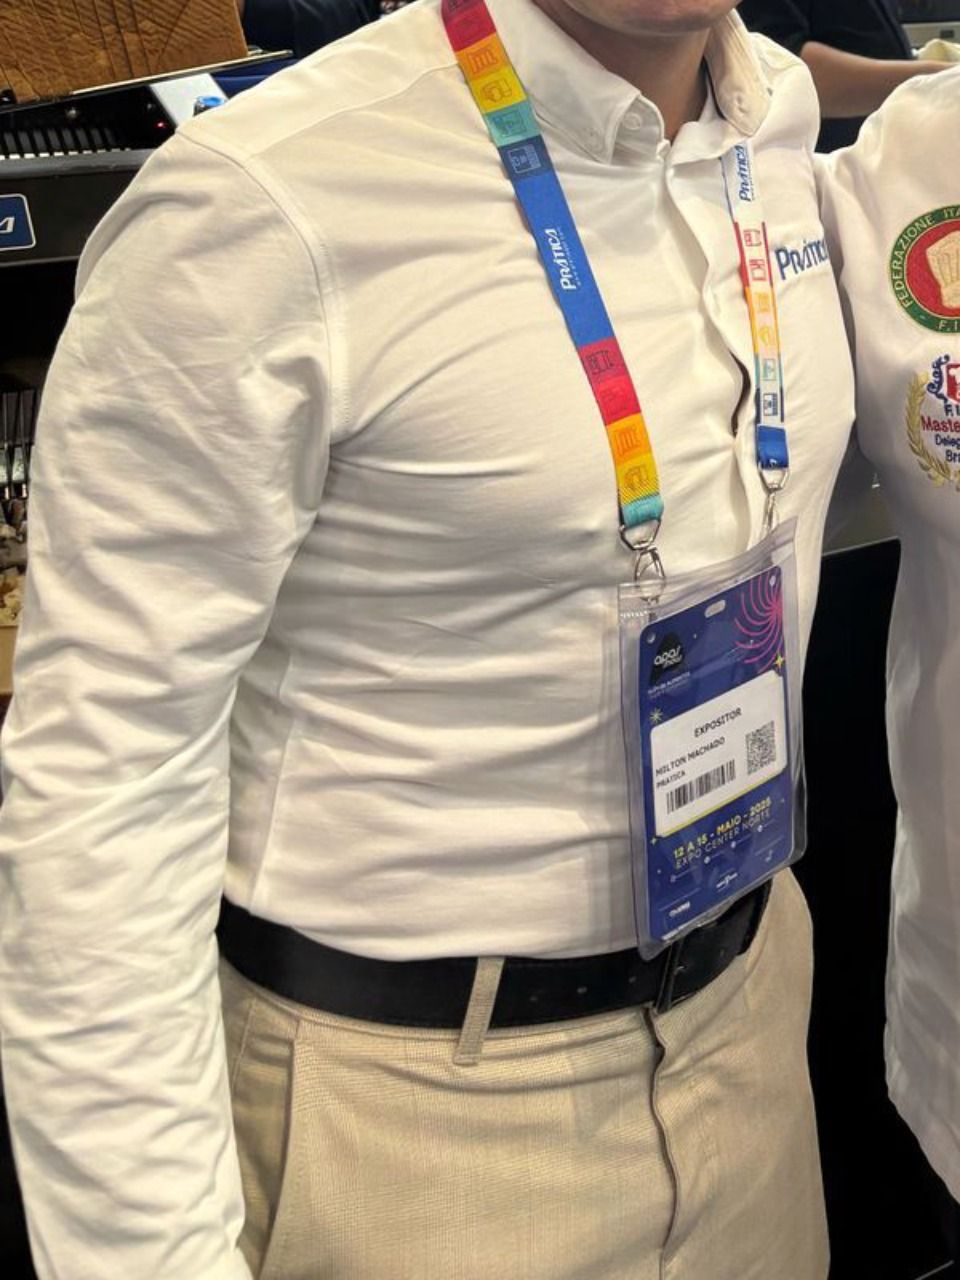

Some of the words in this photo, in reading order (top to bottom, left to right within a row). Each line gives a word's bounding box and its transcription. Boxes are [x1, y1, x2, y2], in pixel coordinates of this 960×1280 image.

[544, 228, 577, 290] PRÁTICA
[892, 214, 936, 309] FEDERAZIONE
[694, 707, 742, 738] EXPOSITOR
[655, 756, 687, 777] MILTON
[687, 736, 725, 761] MACHADO
[674, 846, 685, 859] 12
[687, 841, 695, 853] A
[716, 814, 741, 836] MAIO
[750, 796, 772, 818] 2025
[675, 848, 702, 870] EXPO
[705, 826, 740, 853] CENTER
